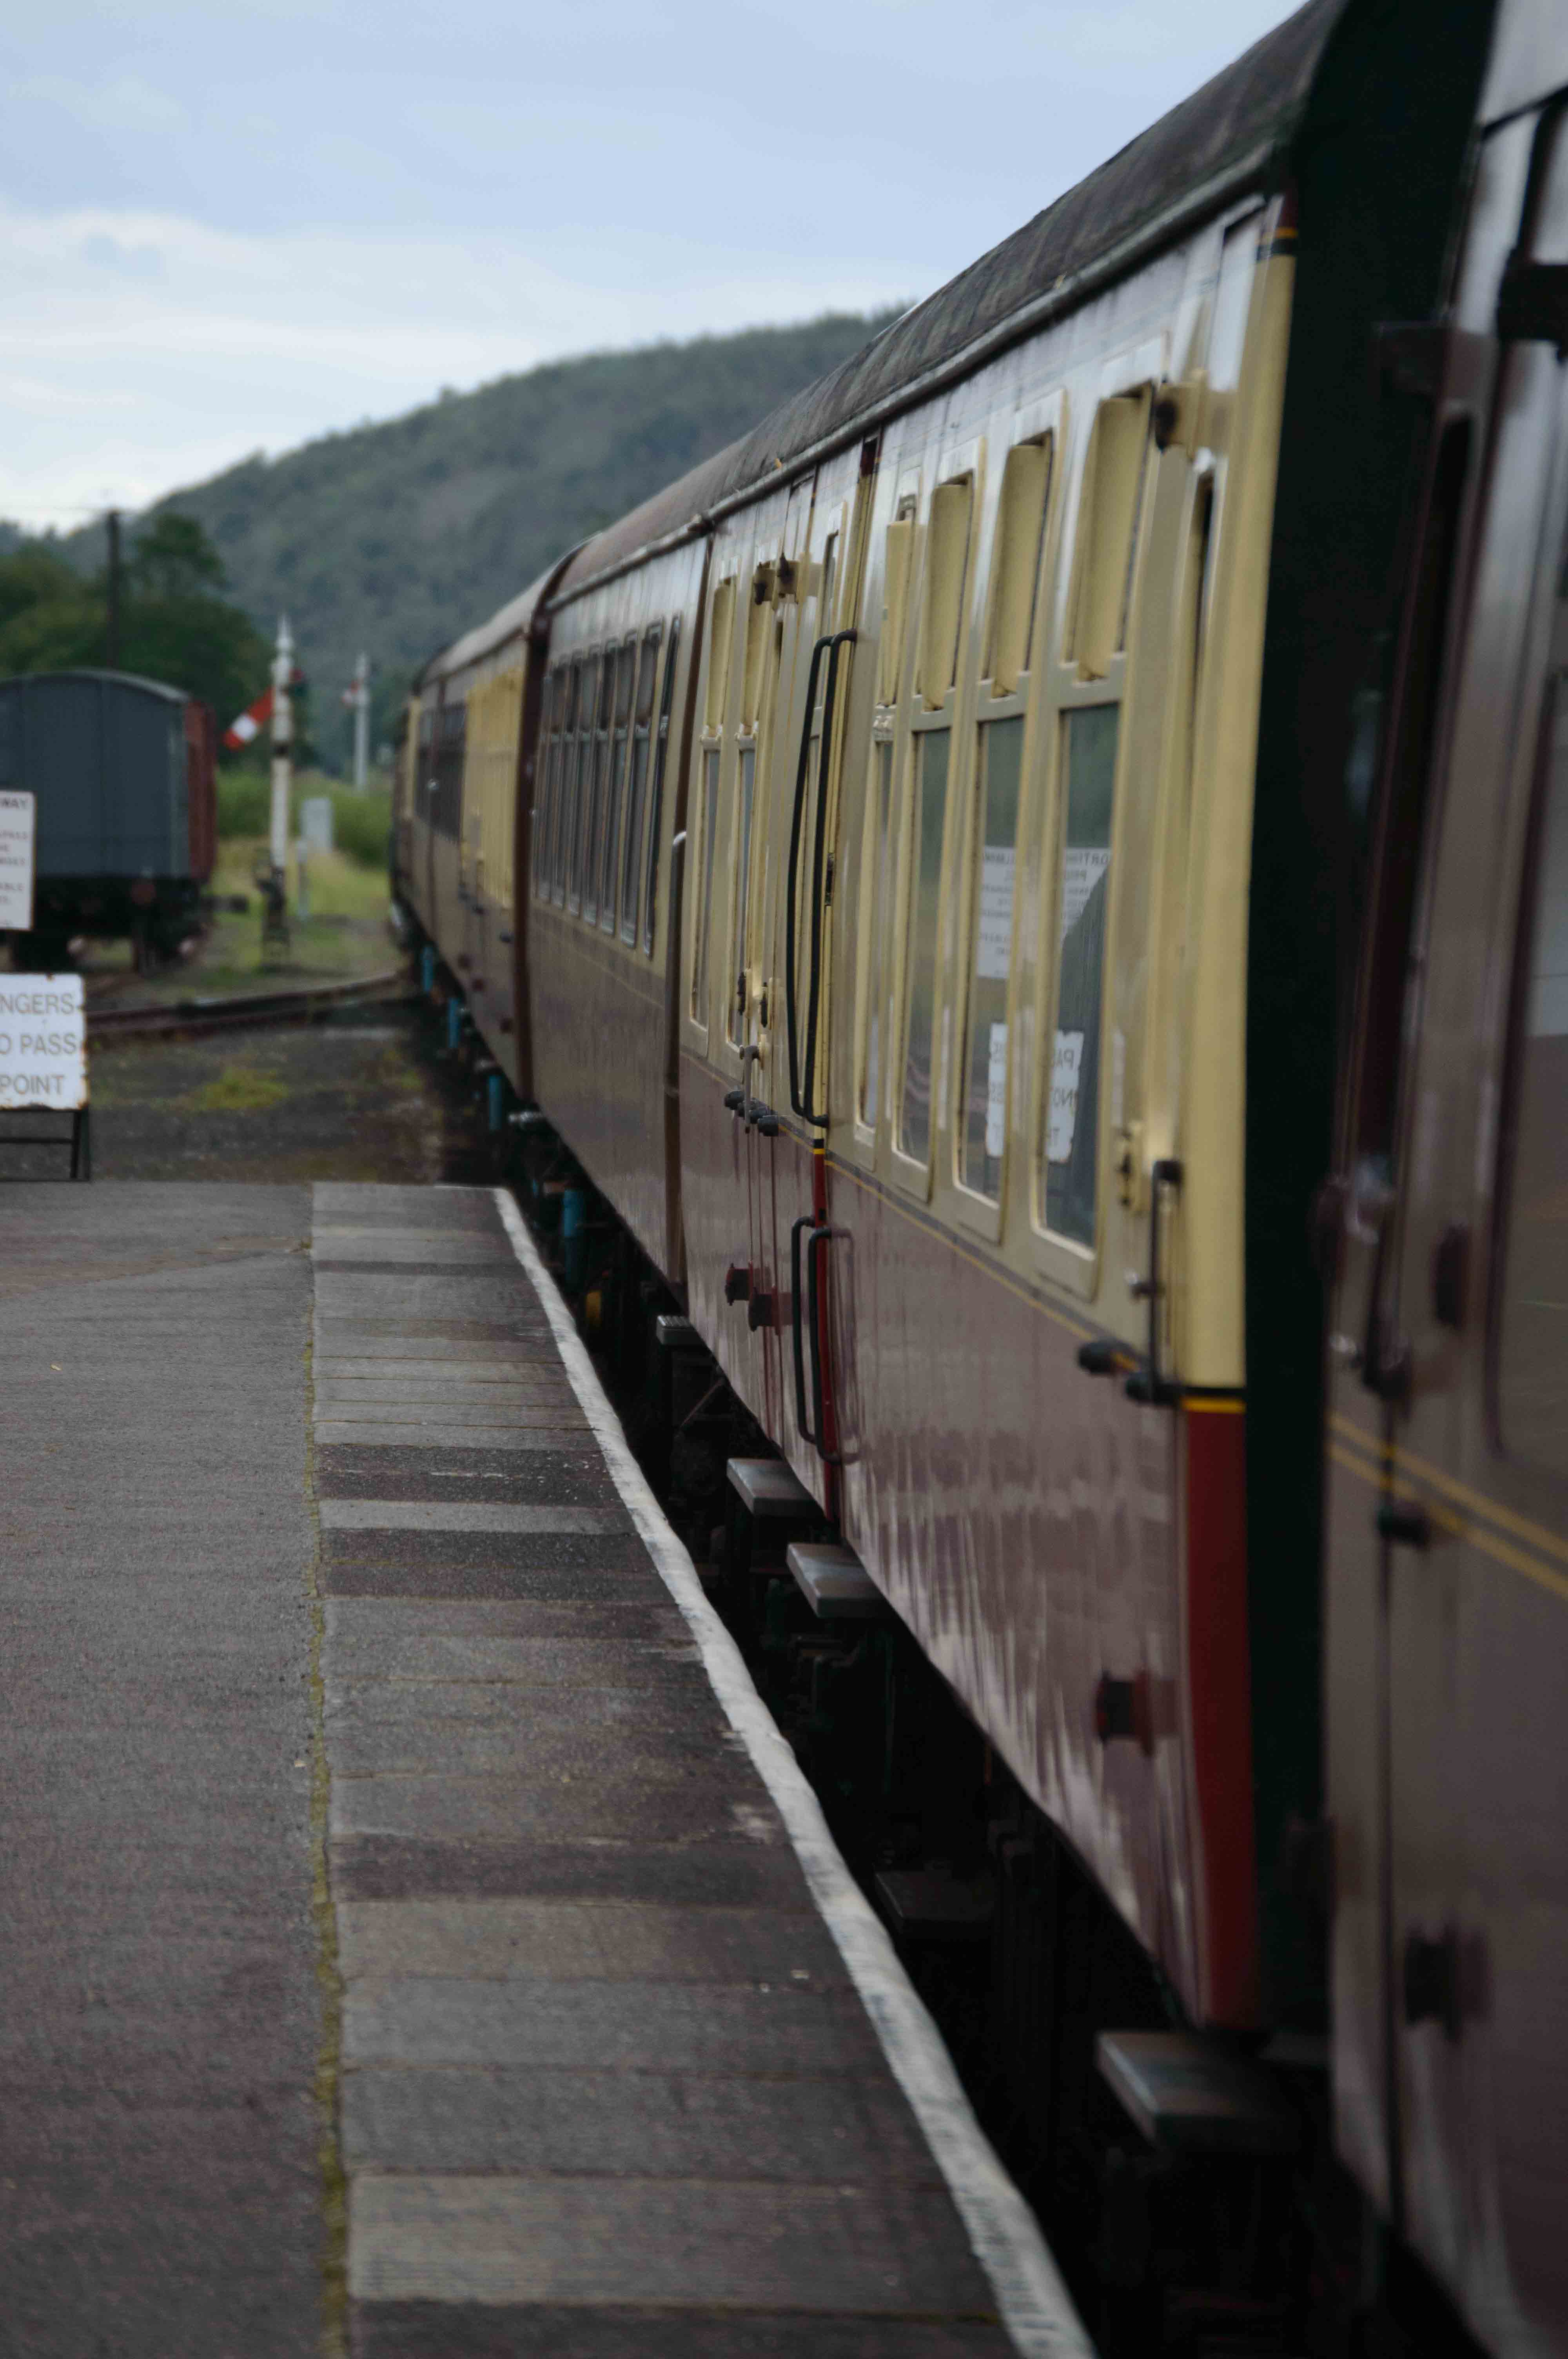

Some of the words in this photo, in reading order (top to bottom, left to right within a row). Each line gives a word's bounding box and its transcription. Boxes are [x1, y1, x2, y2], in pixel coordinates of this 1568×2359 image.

[0, 993, 74, 1015] NGERS
[20, 1032, 77, 1055] PASS
[0, 1074, 65, 1095] POINT
